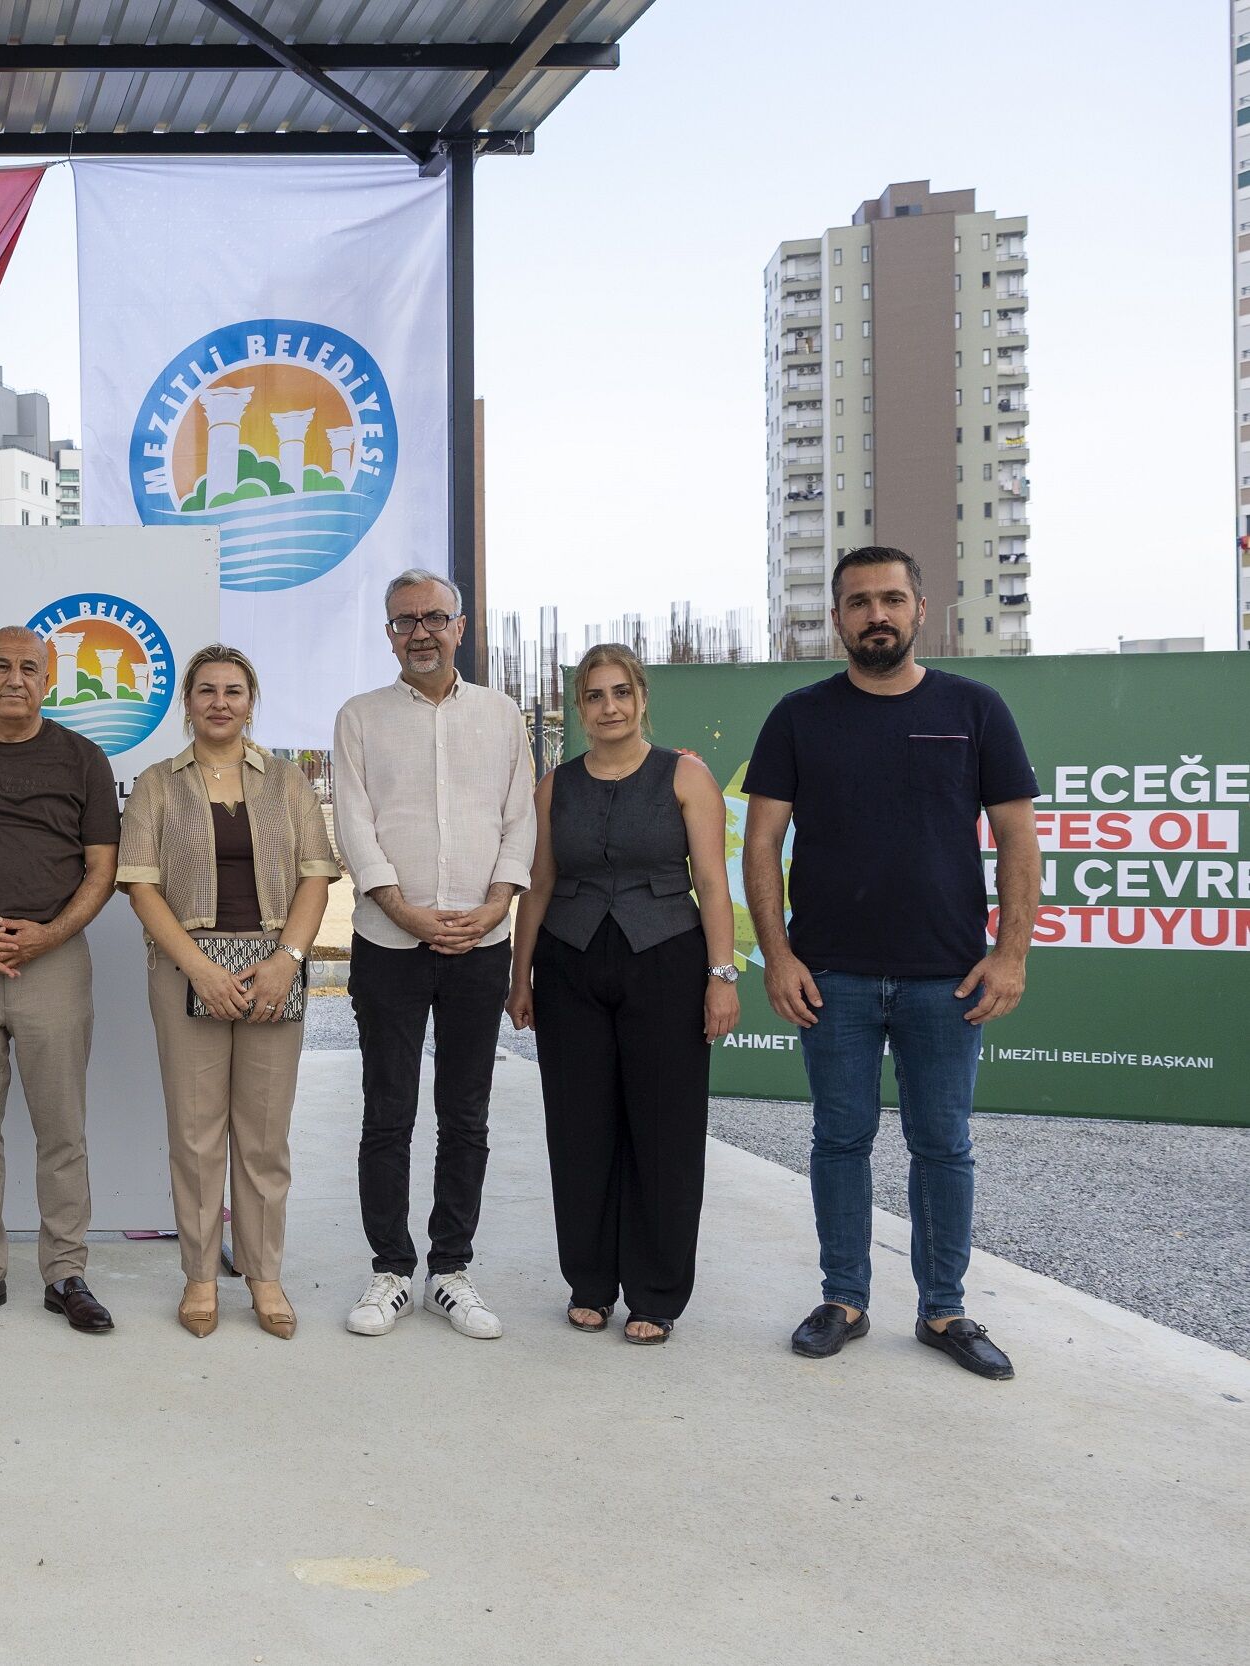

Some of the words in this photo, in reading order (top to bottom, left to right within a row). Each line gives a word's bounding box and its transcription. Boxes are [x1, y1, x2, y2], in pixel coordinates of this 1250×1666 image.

[143, 346, 226, 495] MEZİTLİ
[246, 333, 384, 477] BELEDİYESİ
[79, 601, 167, 695] BELEDİYESİ
[1149, 812, 1228, 850] OL
[722, 1032, 798, 1051] AHMET
[998, 1048, 1058, 1062] MEZİTLİ
[1062, 1050, 1138, 1066] BELEDİYE
[1141, 1054, 1214, 1069] BAŞKANI
